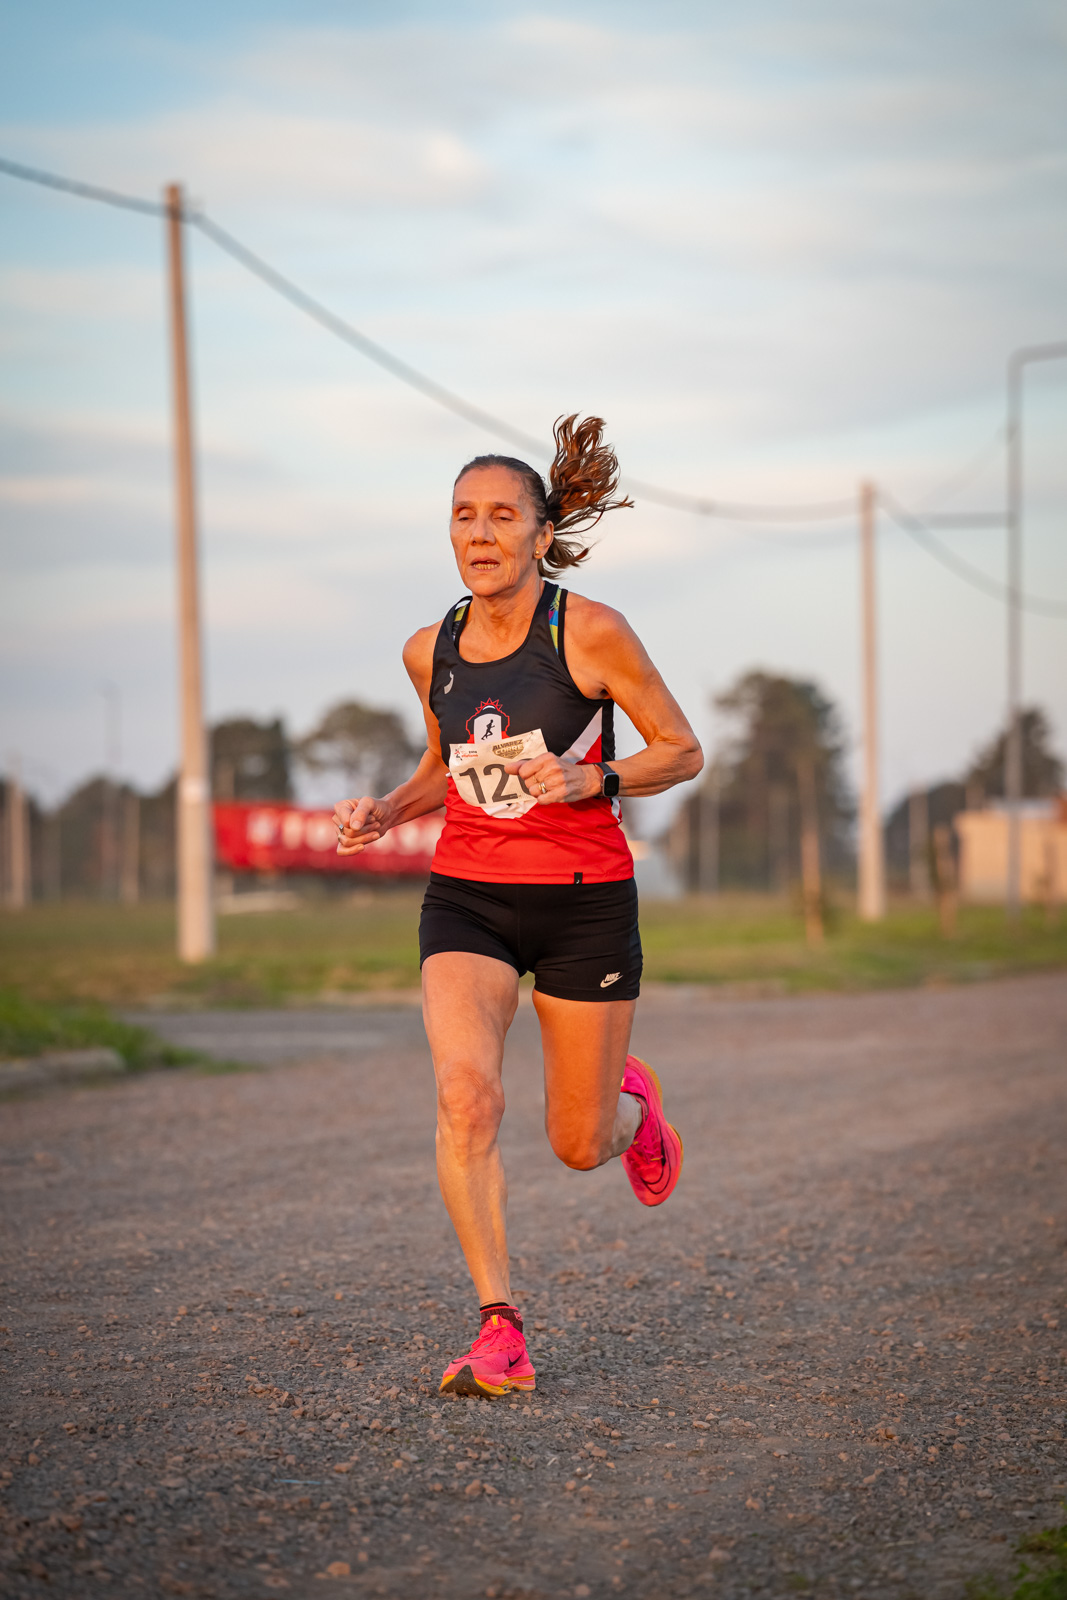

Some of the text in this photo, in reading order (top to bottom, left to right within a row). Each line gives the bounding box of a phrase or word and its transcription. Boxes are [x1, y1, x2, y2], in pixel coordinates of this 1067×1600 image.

[493, 739, 523, 751] ALVAREZ
[495, 744, 523, 755] CORRE
[604, 971, 621, 982] NIKE
